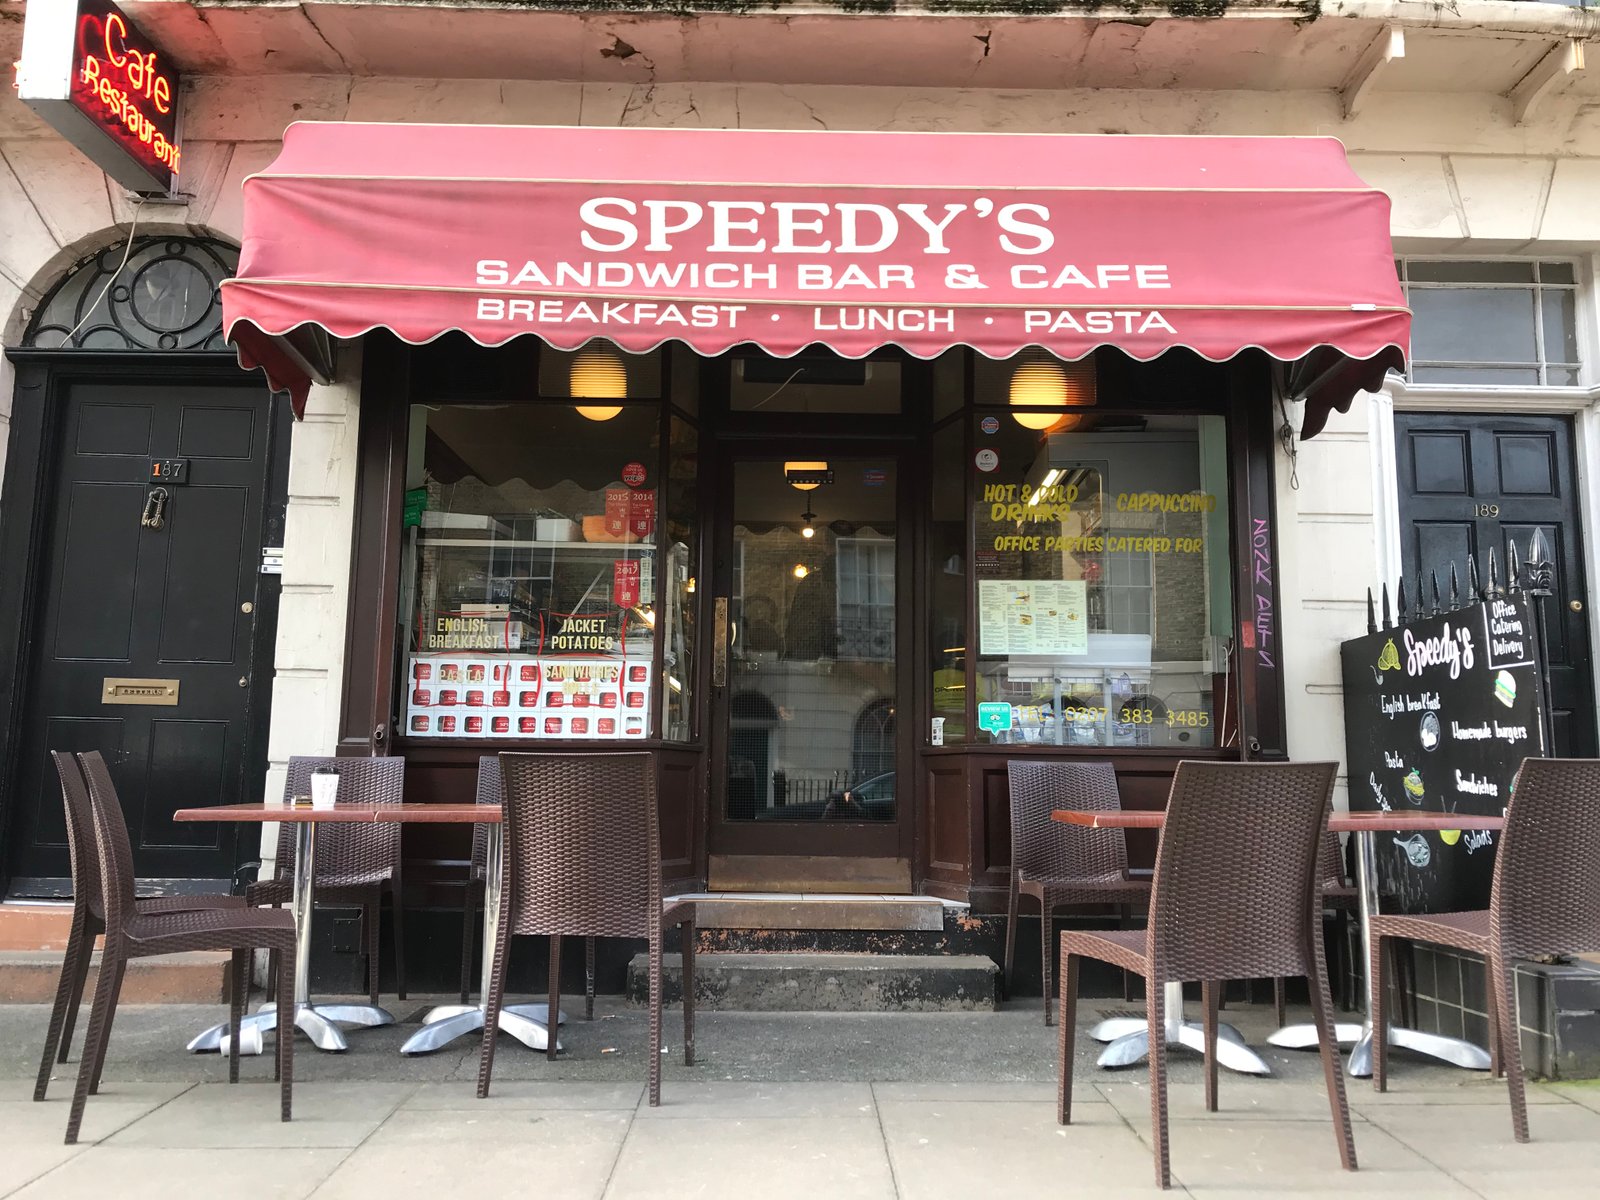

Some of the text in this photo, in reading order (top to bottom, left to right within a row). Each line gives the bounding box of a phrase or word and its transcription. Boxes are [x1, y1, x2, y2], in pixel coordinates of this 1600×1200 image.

[105, 13, 169, 114] Cafe
[81, 55, 181, 174] Restaurant
[579, 197, 1055, 255] SPEEDY'S
[476, 260, 1172, 290] SANDWICH BAR & CAFE
[476, 298, 1178, 334] BREAKFAST LUNCH PASTA
[152, 463, 183, 477] 187
[608, 492, 629, 501] 2015
[632, 493, 653, 501] 2014
[984, 484, 1079, 503] HOT & COLD
[1116, 493, 1217, 513] CAPPUCCINO
[990, 503, 1071, 523] DRINKS
[1473, 503, 1499, 518] 189
[994, 536, 1204, 553] OFFICE PARTIES CATERED FOR
[1492, 599, 1517, 618] Office
[437, 618, 488, 633] ENGLISH
[561, 619, 606, 633] JACKET
[1491, 618, 1523, 635] Catering
[429, 635, 500, 649] BREAKFAST
[551, 636, 614, 650] POTATOES
[1492, 639, 1524, 660] Delivery
[438, 668, 483, 683] PASTA
[1065, 706, 1108, 722] 0207
[1121, 708, 1153, 724] 383
[1165, 709, 1209, 727] 3485
[1381, 694, 1405, 720] English
[1451, 720, 1527, 744] Homemade burgers
[1384, 750, 1404, 769] Pasta
[1455, 768, 1498, 797] Sandwiches
[1464, 830, 1493, 855] Salads
